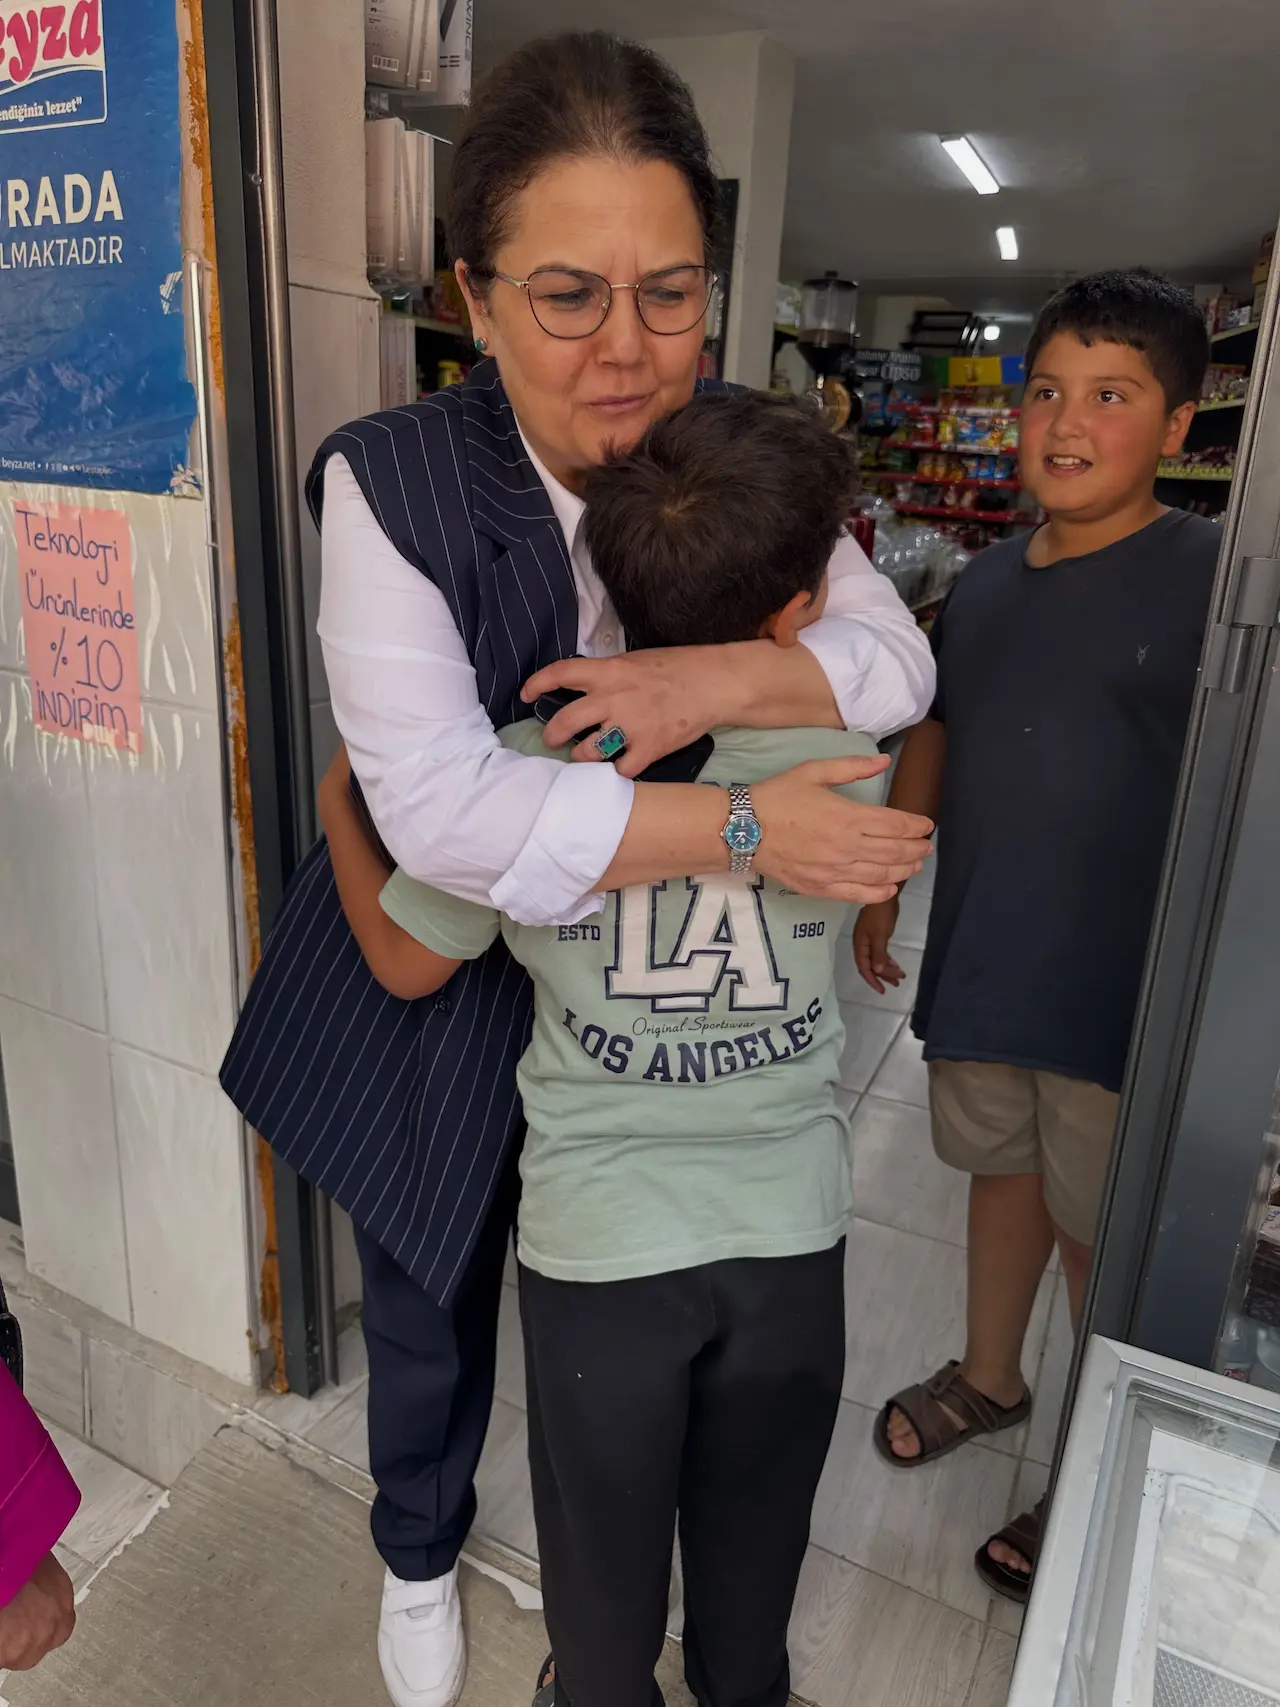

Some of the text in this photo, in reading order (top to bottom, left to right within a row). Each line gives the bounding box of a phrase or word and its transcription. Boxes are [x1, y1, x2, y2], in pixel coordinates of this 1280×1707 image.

[0, 0, 101, 83] yza
[0, 170, 124, 228] RADA
[558, 924, 601, 942] ESTD
[605, 872, 790, 1013] LA
[792, 921, 825, 939] 1980
[562, 997, 822, 1083] LOS ANGELES
[632, 1014, 755, 1038] Original Sportswear
